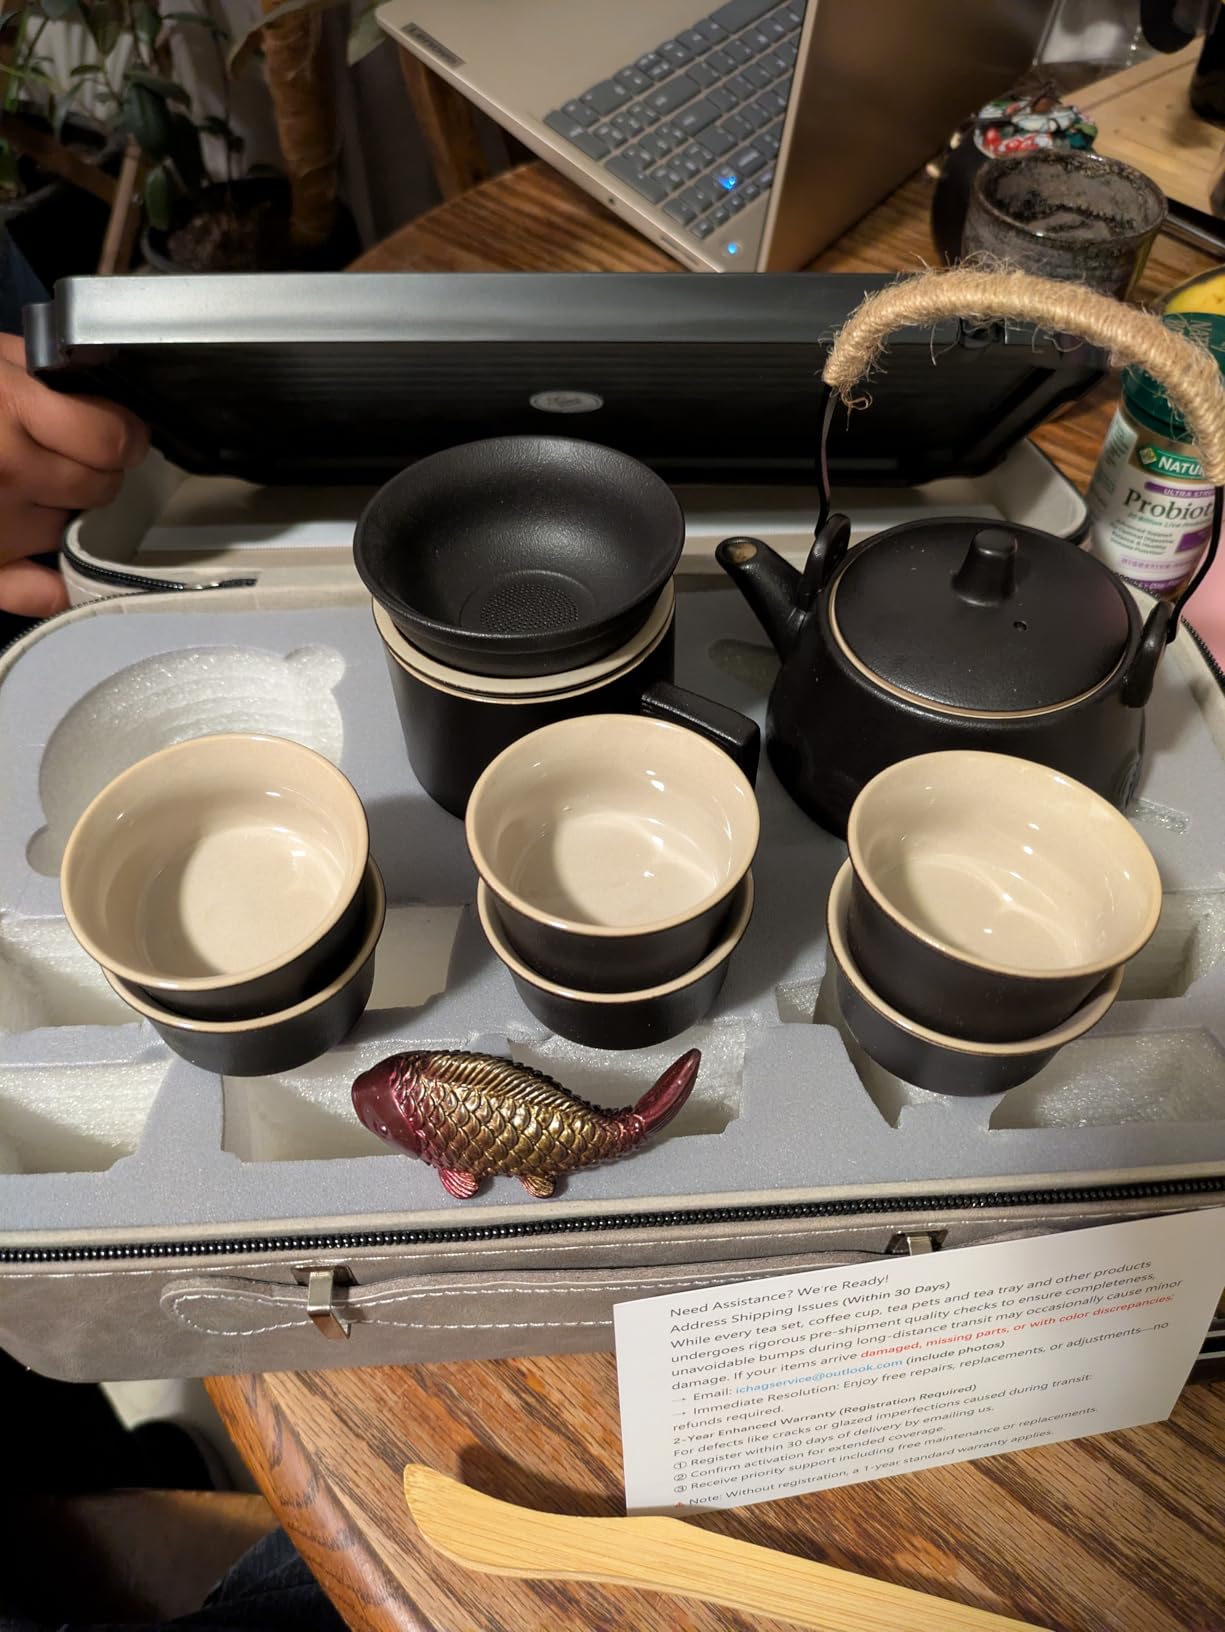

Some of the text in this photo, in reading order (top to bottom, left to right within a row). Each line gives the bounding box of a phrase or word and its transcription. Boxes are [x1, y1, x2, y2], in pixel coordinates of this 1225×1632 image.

[670, 1275, 889, 1317] Need Assistance? We're Ready!
[671, 1261, 1152, 1348] While every tea set, coffee cup, tea pets and tea tray and other products
[671, 1281, 950, 1333] Address Shipping Issues (Within 30 Days)
[671, 1345, 744, 1362] undergoes
[749, 1334, 806, 1350] rigorous
[810, 1318, 901, 1342] pre-shipment
[904, 1310, 950, 1325] quality
[953, 1302, 997, 1315] checks
[1001, 1298, 1014, 1307] to
[1018, 1291, 1062, 1304] ensure
[672, 1280, 1183, 1377] unavoidable bumps during long-distance transit may occasionally cause minor
[672, 1375, 730, 1390] damage.
[734, 1371, 742, 1380] If
[746, 1367, 778, 1380] your
[780, 1360, 816, 1372] items
[820, 1352, 858, 1365] arrive
[860, 1342, 922, 1359] damaged,
[926, 1333, 972, 1347] missing
[976, 1326, 1010, 1340] parts,
[1013, 1323, 1026, 1332] or
[1030, 1317, 1056, 1328] with
[1059, 1312, 1088, 1322] color
[694, 1340, 1005, 1400] Email: ichagservice@outlook.com (include photos)
[694, 1396, 764, 1415] Immediate
[768, 1384, 840, 1402] Resolution:
[843, 1376, 878, 1388] Enjoy
[882, 1372, 906, 1382] free
[910, 1364, 956, 1377] repairs,
[1050, 1342, 1062, 1350] or
[673, 1405, 784, 1432] refunds required.
[674, 1384, 977, 1444] 2-Year Enhanced Warranty (Registration Required)
[674, 1448, 694, 1456] For
[698, 1438, 744, 1452] defects
[748, 1433, 769, 1444] like
[772, 1426, 811, 1439] cracks
[832, 1414, 872, 1430] glazed
[876, 1400, 960, 1420] imperfections
[963, 1390, 1006, 1404] caused
[1009, 1382, 1048, 1396] during
[691, 1451, 742, 1466] Register
[746, 1443, 784, 1455] within
[786, 1440, 802, 1448] 30
[806, 1434, 834, 1446] days
[837, 1431, 851, 1439] of
[856, 1423, 902, 1436] delivery
[904, 1418, 920, 1427] by
[922, 1409, 974, 1424] emailing
[689, 1494, 722, 1506] Note:
[726, 1484, 775, 1498] Without
[778, 1470, 850, 1489] registration,
[864, 1459, 900, 1472] 1-year
[903, 1448, 955, 1464] standard
[958, 1438, 1008, 1452] warranty
[1010, 1429, 1054, 1444] applies.
[690, 1463, 741, 1478] Confirm
[744, 1452, 804, 1468] activation
[808, 1448, 824, 1456] for
[828, 1436, 886, 1452] extended
[888, 1426, 946, 1442] coverage.
[691, 1476, 738, 1490] Receive
[741, 1466, 786, 1482] priority
[788, 1458, 836, 1472] support
[839, 1445, 894, 1462] including
[898, 1440, 922, 1450] free
[924, 1426, 1000, 1446] maintenance
